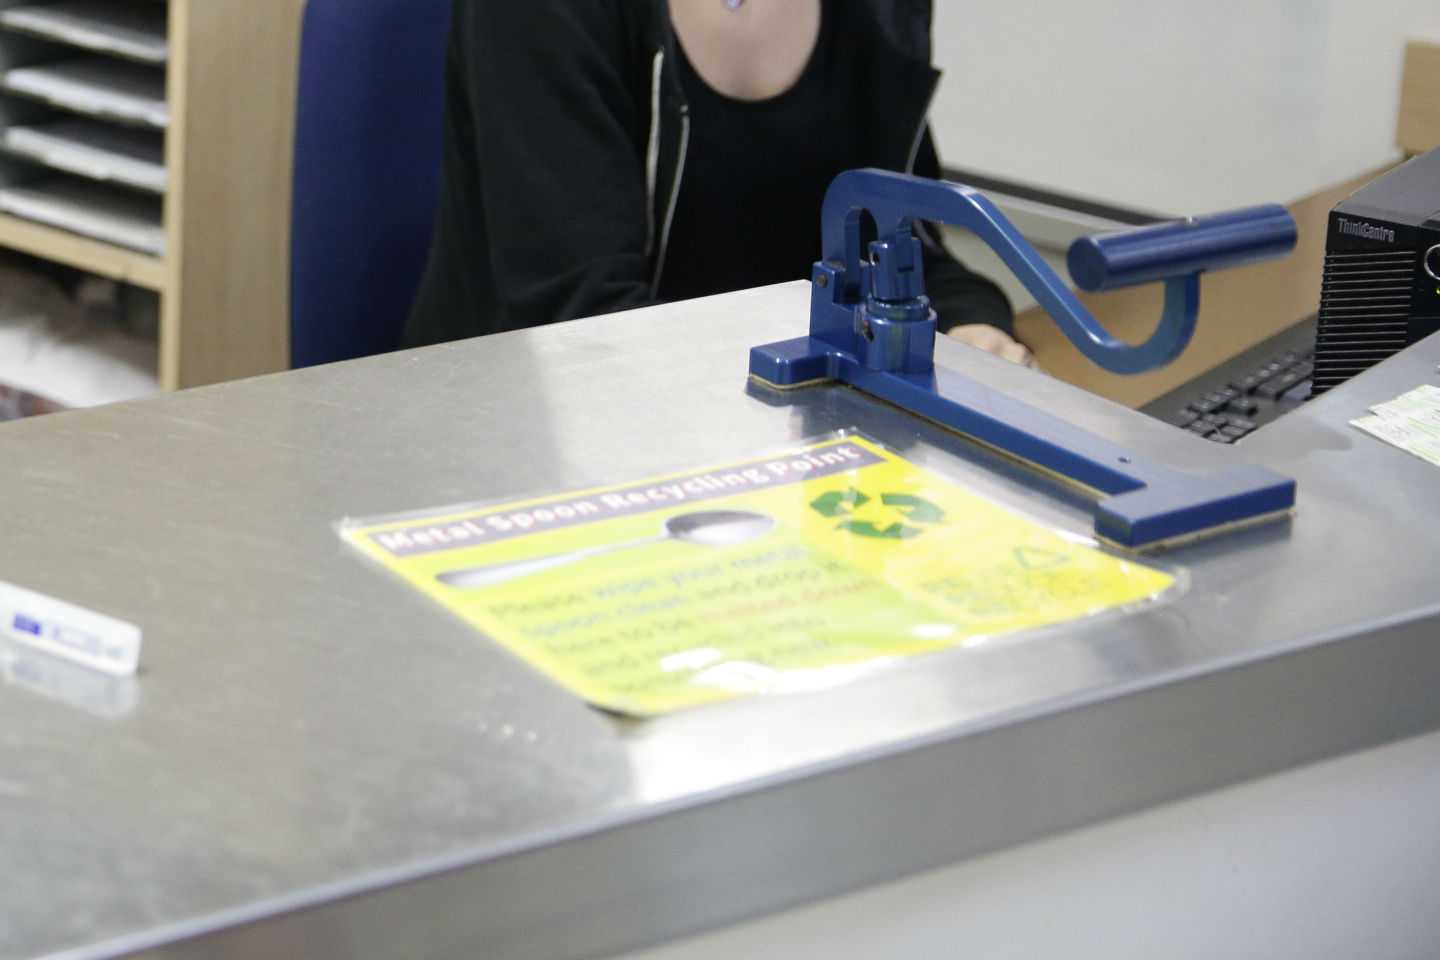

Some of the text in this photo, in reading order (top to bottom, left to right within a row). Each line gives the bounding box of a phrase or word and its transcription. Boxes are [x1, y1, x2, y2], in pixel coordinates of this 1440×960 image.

[1338, 218, 1395, 242] ThinkCentre
[377, 445, 862, 548] Metal Spoon Recycling Point
